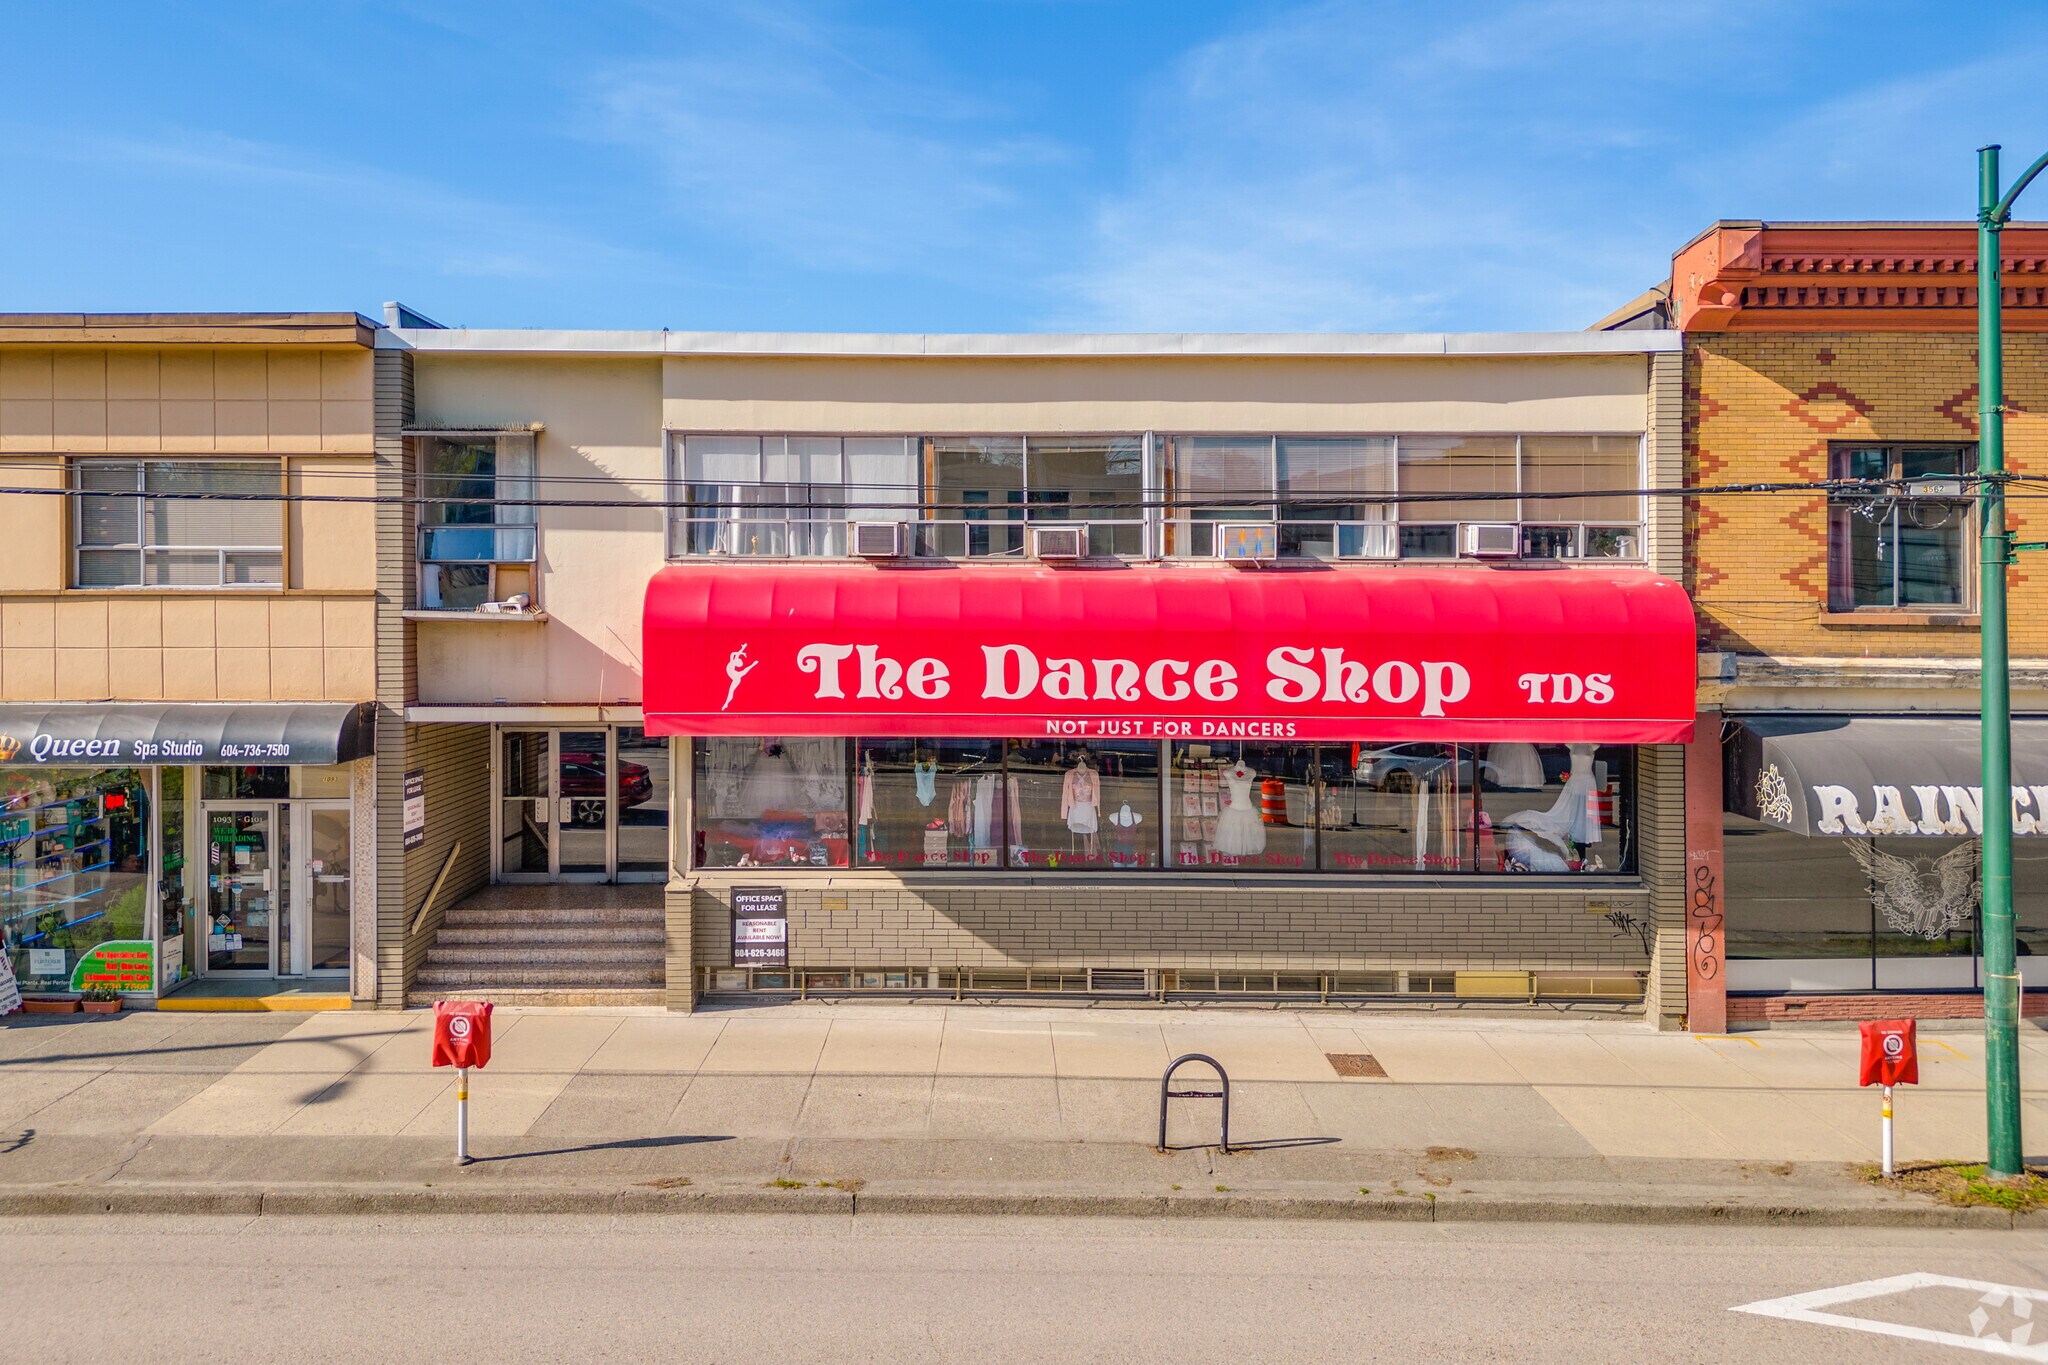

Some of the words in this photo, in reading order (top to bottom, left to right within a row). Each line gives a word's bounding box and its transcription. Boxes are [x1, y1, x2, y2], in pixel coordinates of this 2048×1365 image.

[797, 643, 951, 701] The
[981, 644, 1239, 702] Dance
[1266, 646, 1471, 718] Shop
[1518, 673, 1615, 704] TDS
[1046, 720, 1088, 735] NOT
[1097, 720, 1142, 735] JUST
[1153, 721, 1193, 736] FOR
[1203, 721, 1297, 738] DANCERS
[30, 733, 121, 762] Queen
[133, 740, 158, 760] Spa
[162, 739, 204, 757] Studio
[220, 744, 290, 757] 604-736-7500
[213, 816, 232, 824] 1093
[214, 835, 257, 843] THREADING
[865, 850, 894, 863] The
[898, 850, 947, 863] Dance
[953, 851, 991, 865] Shop
[1020, 851, 1048, 864] The
[1054, 851, 1104, 864] Dance
[1109, 852, 1147, 866] Shop
[1177, 852, 1205, 865] The
[1211, 852, 1260, 865] Dance
[1265, 853, 1305, 867] Shop
[1333, 853, 1364, 866] The
[1367, 853, 1418, 866] Dance
[1423, 854, 1463, 869] Shop
[735, 949, 785, 957] 604-626-3468
